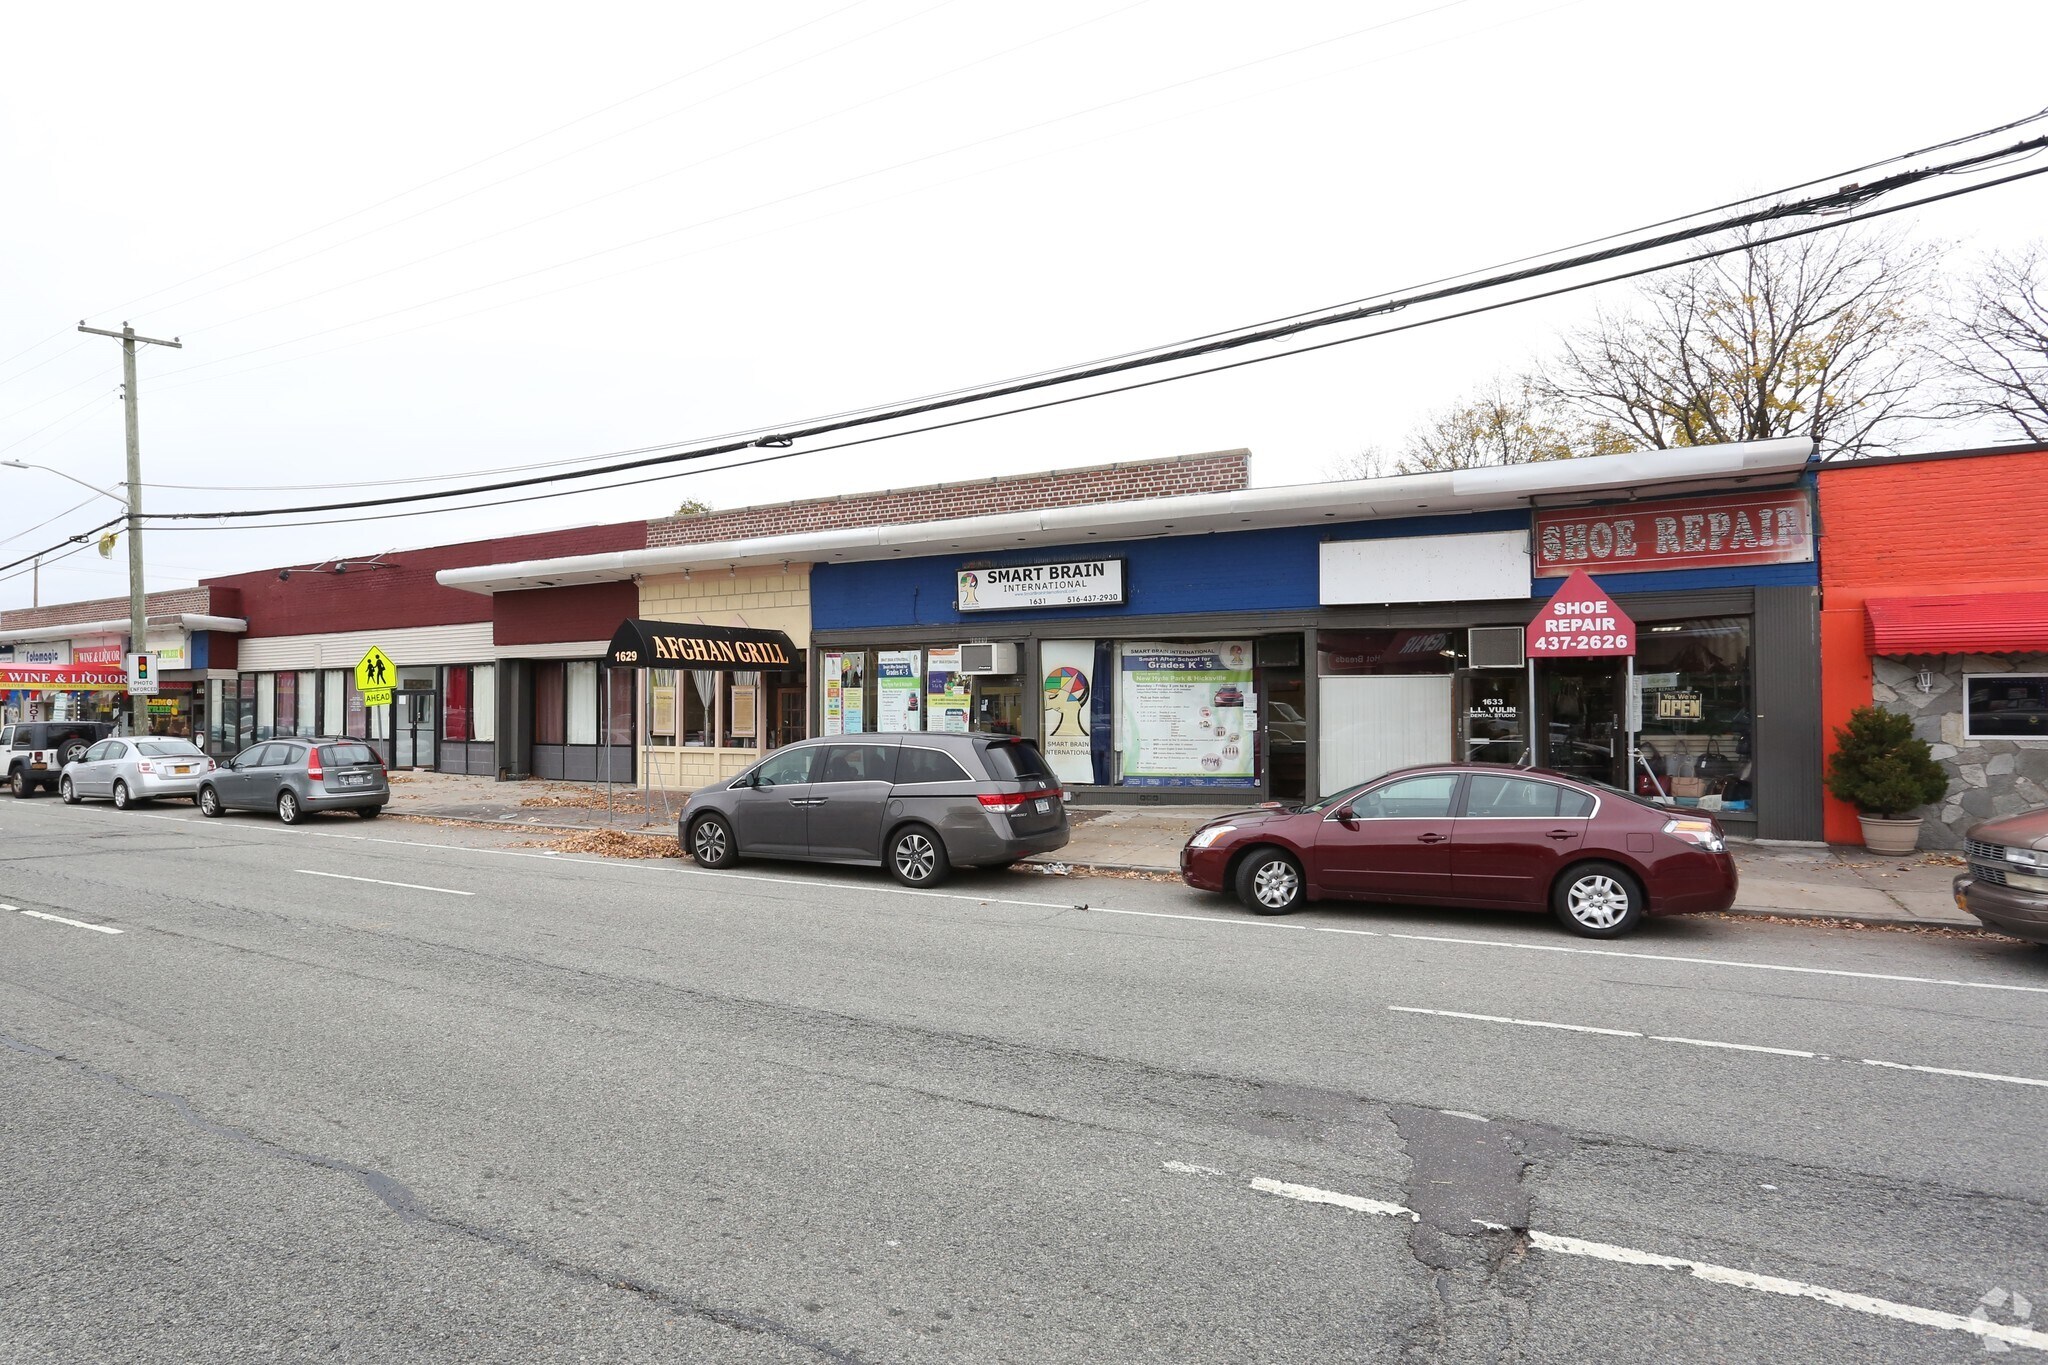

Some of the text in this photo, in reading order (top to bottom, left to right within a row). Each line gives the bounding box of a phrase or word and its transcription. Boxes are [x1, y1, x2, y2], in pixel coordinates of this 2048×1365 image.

[1542, 506, 1804, 561] SHOE REPAIR
[987, 563, 1105, 584] SMART BRAIN
[1003, 580, 1087, 593] INTERNATIONAL
[1067, 594, 1118, 603] 516-437-2930
[1553, 601, 1608, 615] SHOE
[1545, 617, 1616, 632] REPAIR
[1534, 634, 1628, 650] 437-2626
[79, 651, 93, 663] WINE
[98, 648, 120, 664] LIQUOR
[614, 651, 637, 662] 1629
[652, 635, 790, 664] AFGHAN GRILL
[1147, 661, 1185, 669] Grades
[1188, 661, 1197, 669] K
[1206, 661, 1213, 669] 5
[8, 672, 51, 683] WINE
[54, 672, 66, 683] &
[71, 671, 128, 685] LIQUOR
[147, 698, 179, 706] LEMON
[366, 693, 390, 702] AHEAD
[1660, 699, 1700, 717] OPEN
